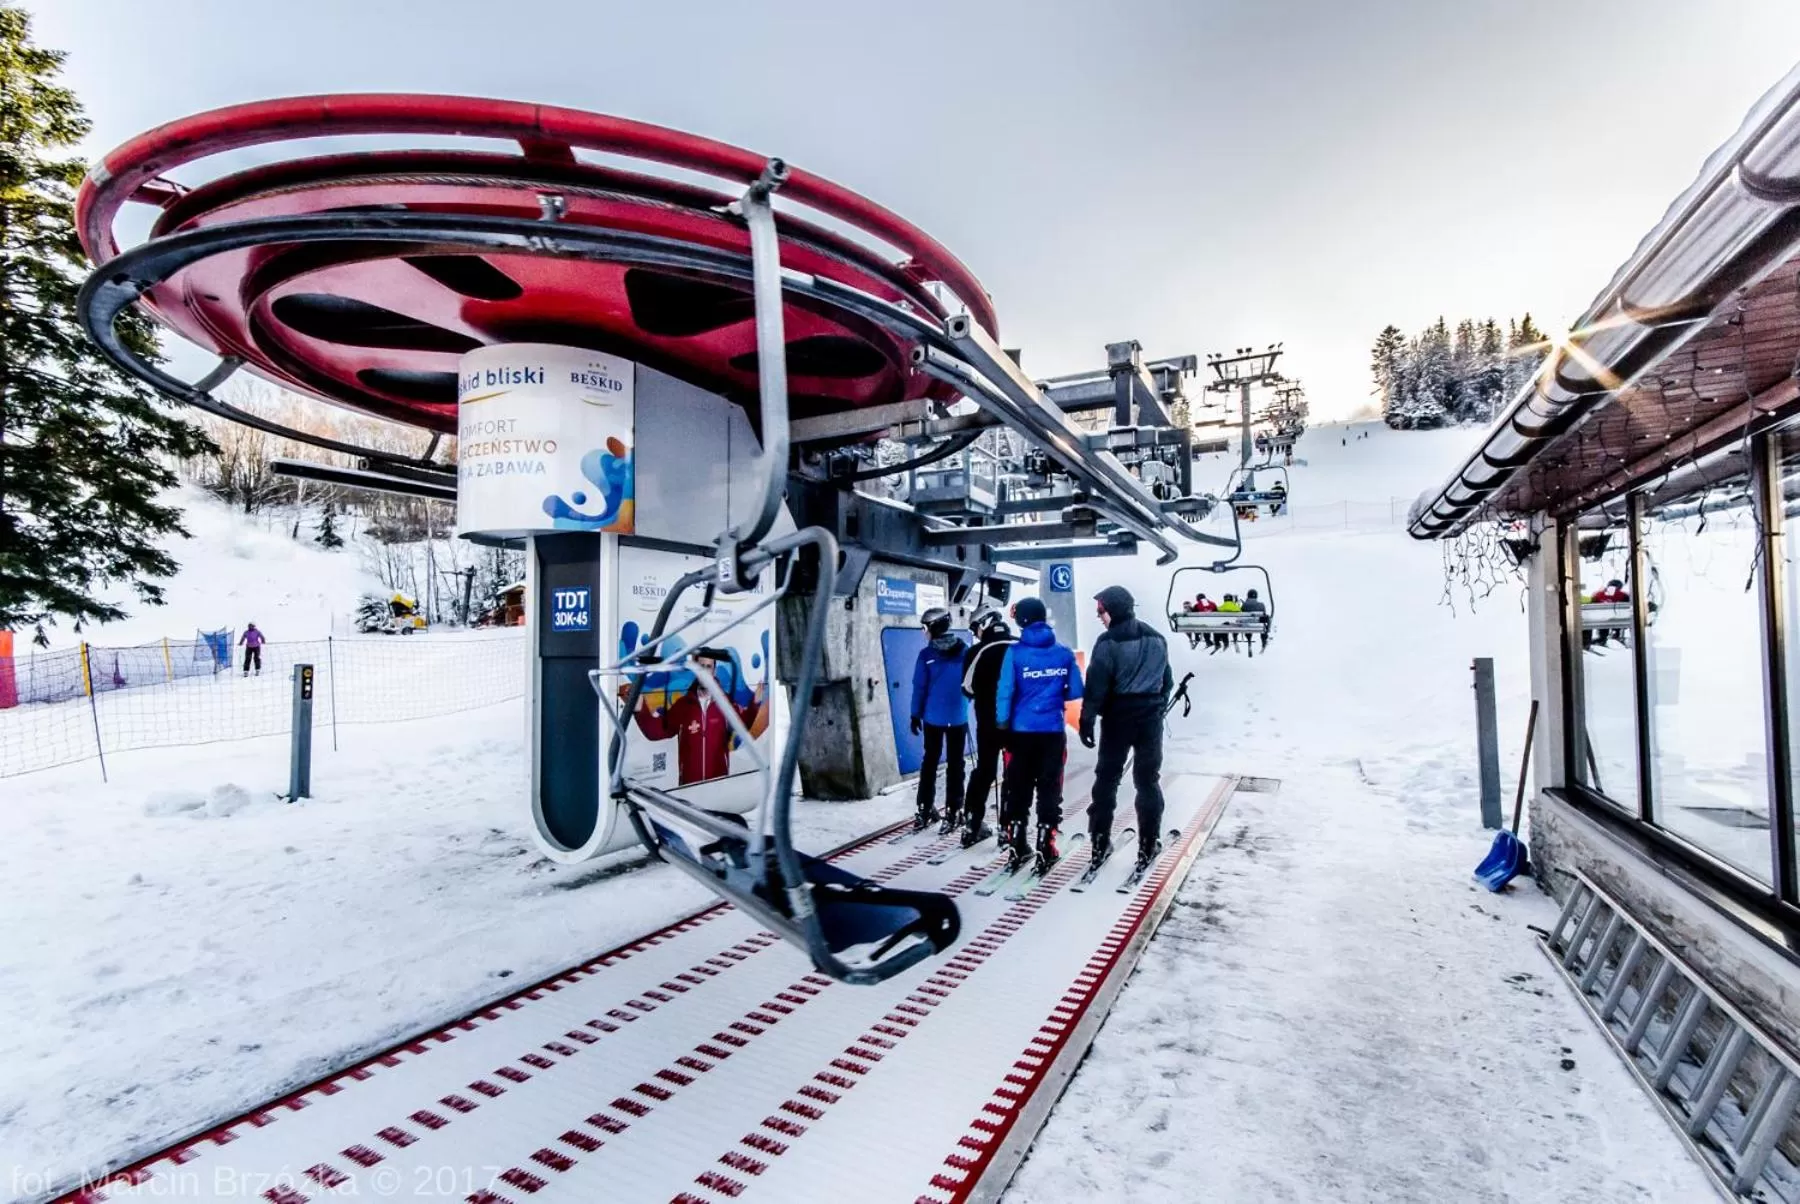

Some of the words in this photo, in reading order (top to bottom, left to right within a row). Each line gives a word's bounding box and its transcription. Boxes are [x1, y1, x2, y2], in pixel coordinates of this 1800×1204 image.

[486, 367, 545, 387] bliski
[571, 372, 623, 392] BESKID
[476, 459, 547, 478] ZABAWA
[555, 590, 588, 610] TDT
[632, 585, 667, 598] BESKID
[555, 611, 588, 626] 3DK-45
[1023, 668, 1068, 679] POLSKA
